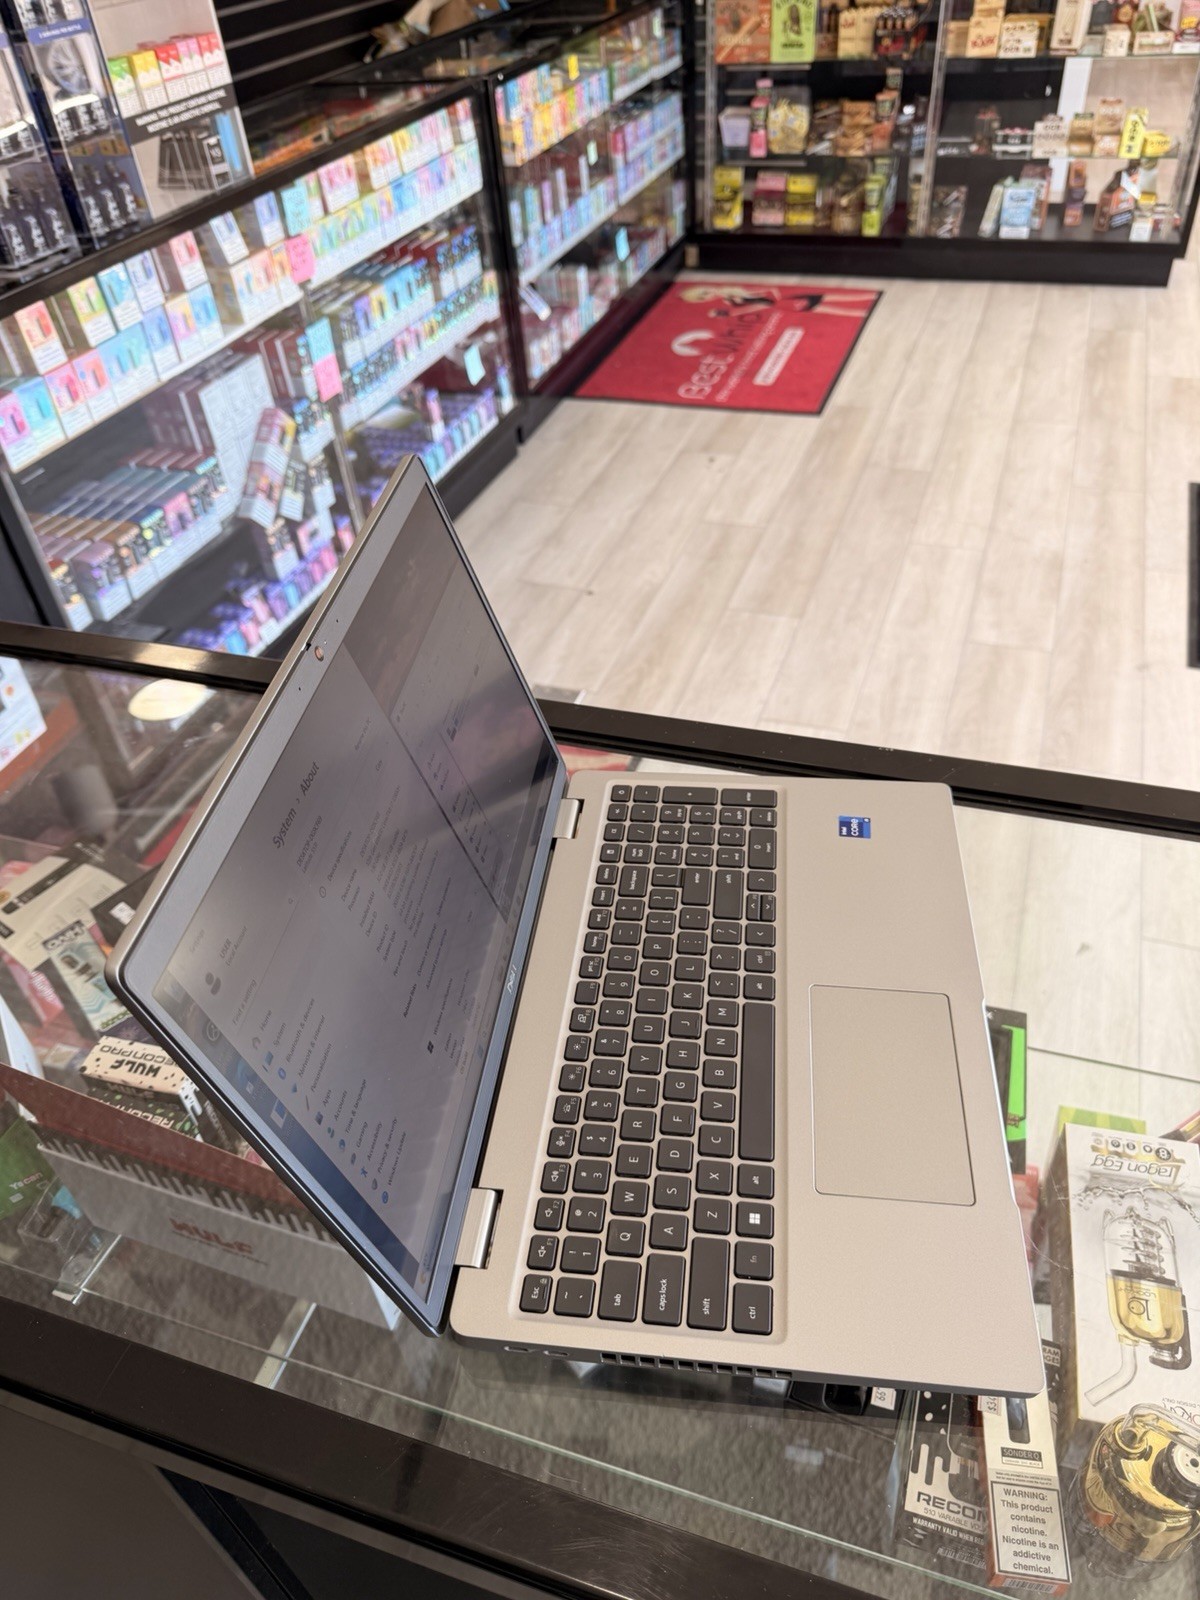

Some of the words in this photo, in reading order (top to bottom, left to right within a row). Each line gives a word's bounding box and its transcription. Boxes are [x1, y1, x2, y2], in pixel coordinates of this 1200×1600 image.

[678, 353, 734, 400] Best
[271, 807, 296, 850] System
[297, 758, 320, 798] About
[218, 939, 232, 960] USER
[260, 1010, 272, 1033] Home
[273, 1023, 286, 1048] System
[285, 1028, 302, 1064] Bluetooth
[302, 998, 315, 1024] devices
[110, 1058, 161, 1078] WULF
[298, 1047, 312, 1079] Network
[310, 1042, 332, 1094] Personalization
[322, 1089, 331, 1107] Apps
[558, 1164, 566, 1173] F3
[1090, 1154, 1124, 1172] Egg
[625, 1192, 634, 1201] W
[620, 1233, 631, 1241] Q
[531, 1287, 539, 1298] Esc
[659, 1294, 667, 1310] caps
[1004, 1488, 1048, 1500] WARNING:
[924, 1508, 936, 1516] 510
[1000, 1500, 1018, 1510] This
[1020, 1502, 1053, 1514] product
[912, 1517, 941, 1531] WARRANTY
[942, 1526, 958, 1536] VALID
[1010, 1513, 1046, 1524] contains
[1011, 1525, 1047, 1537] nicotine.
[1002, 1536, 1037, 1547] Nicotine
[1012, 1549, 1051, 1561] addictive
[1012, 1561, 1054, 1574] chemical.
